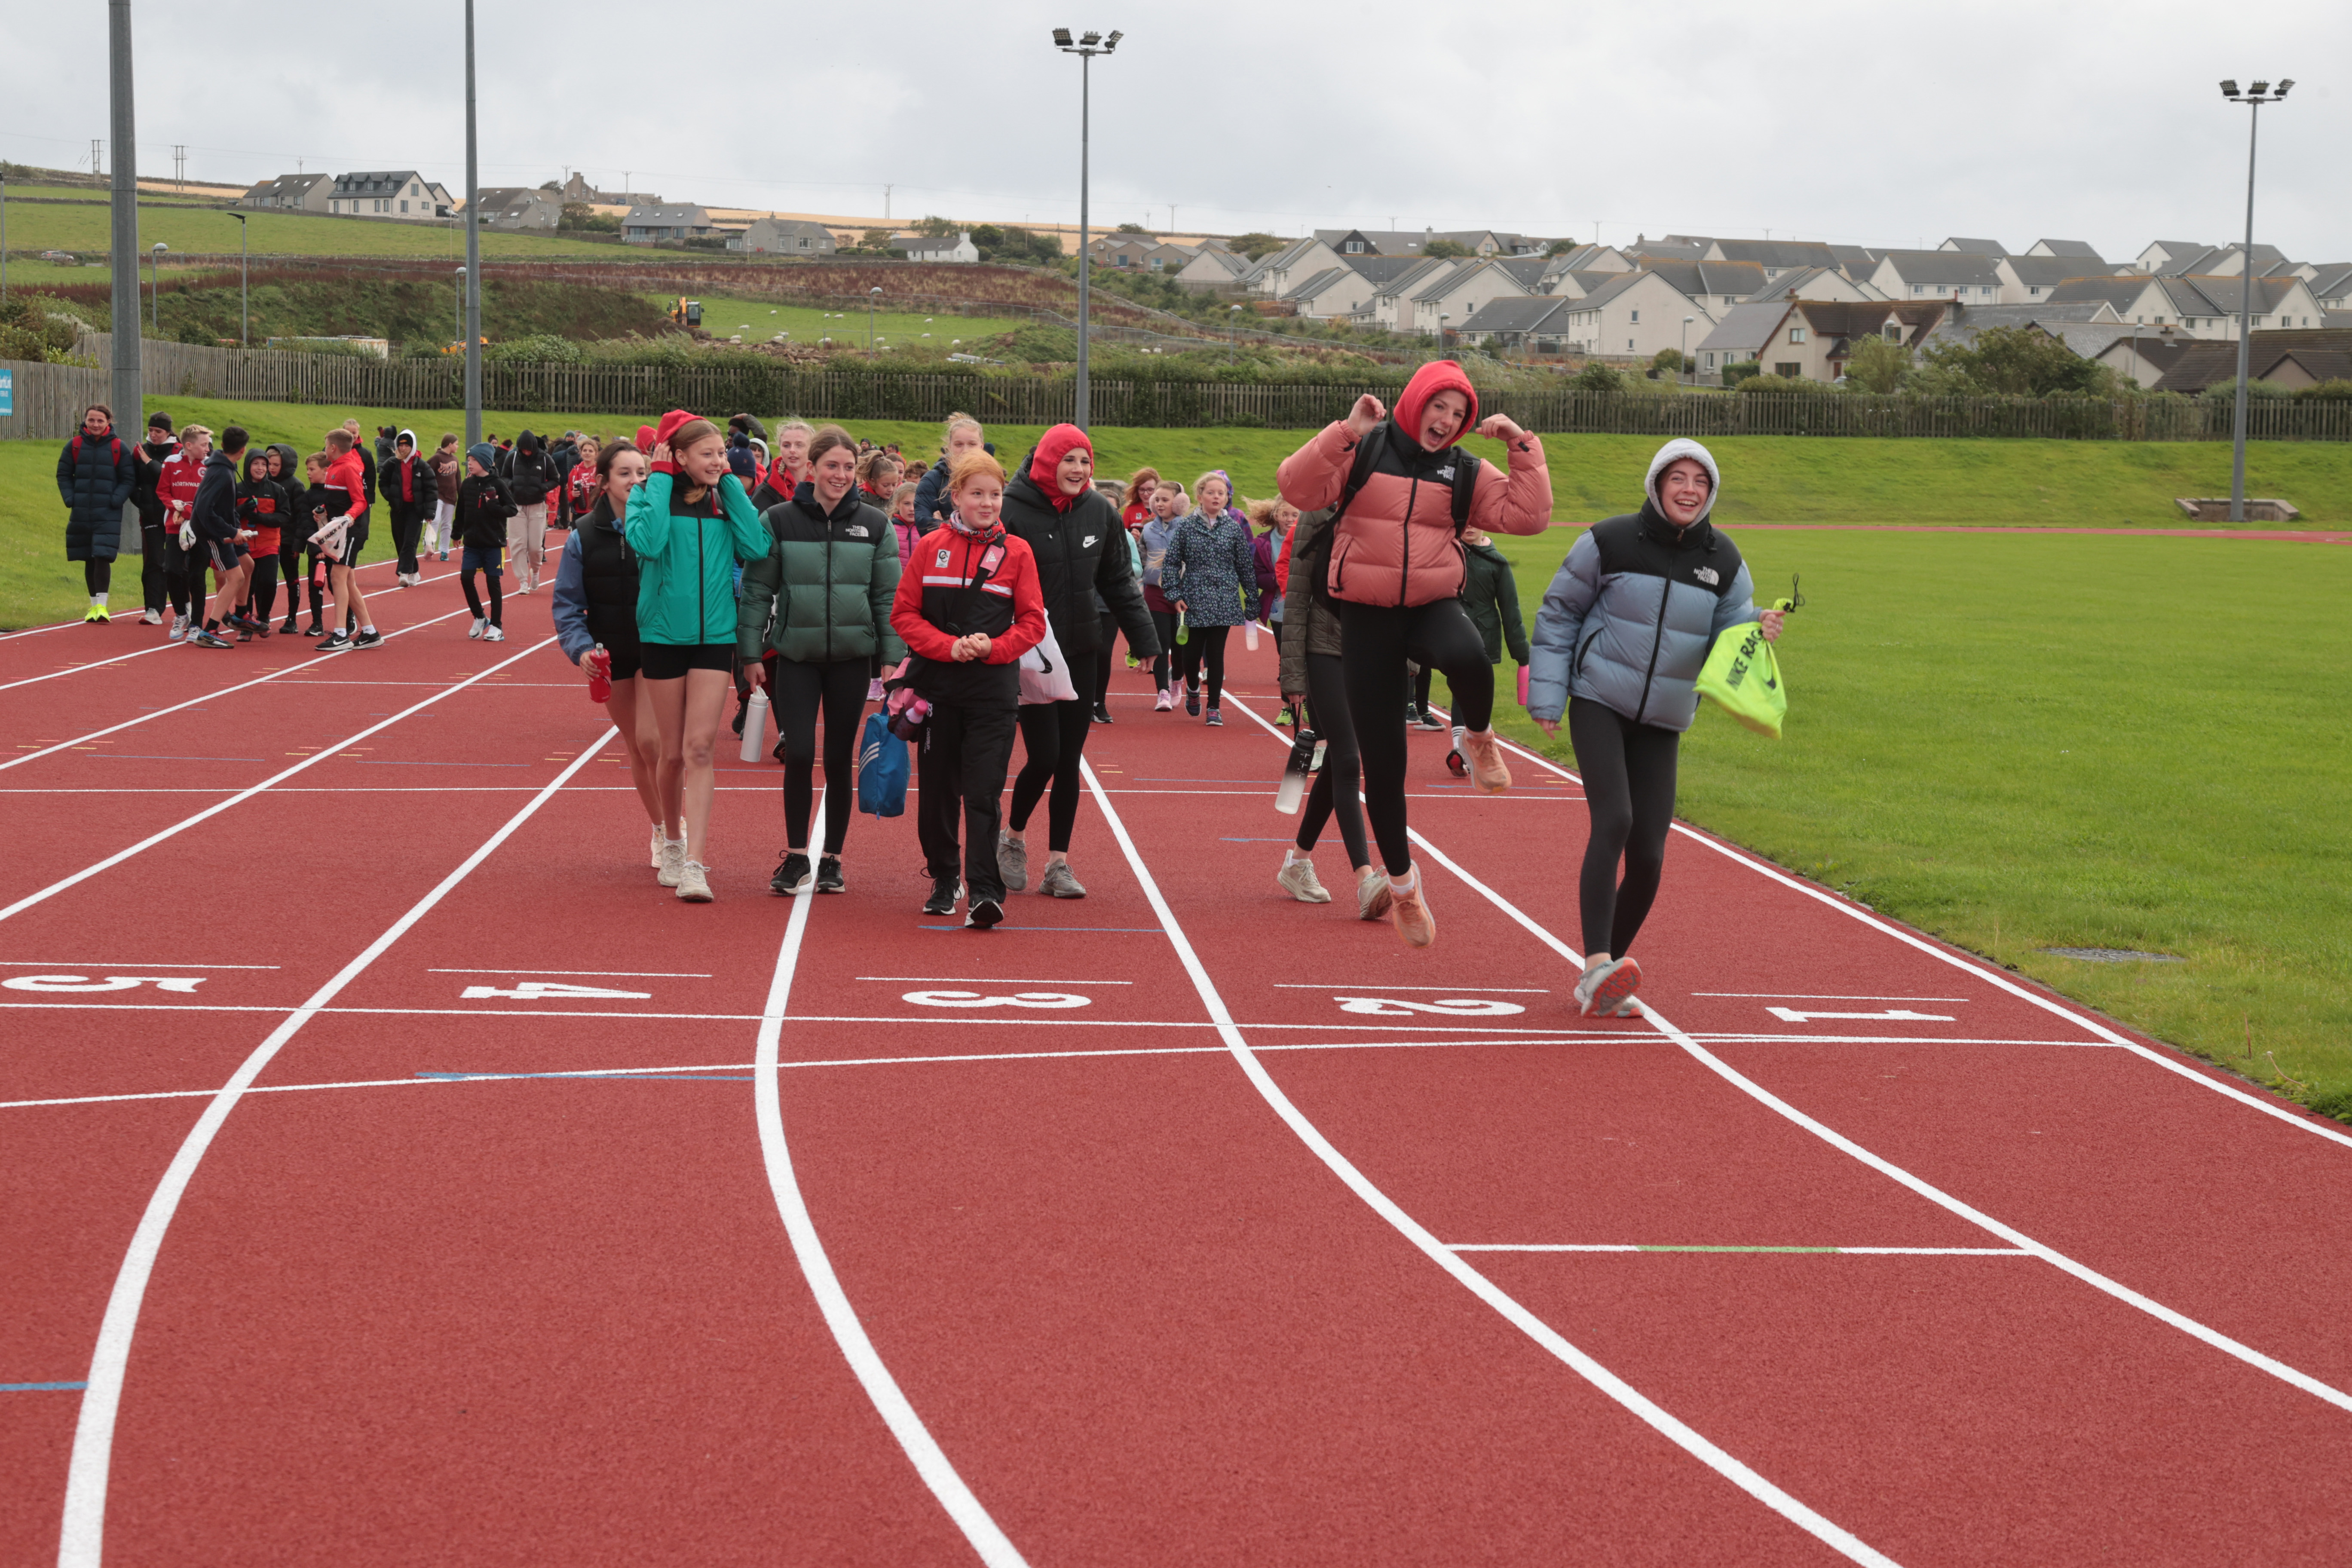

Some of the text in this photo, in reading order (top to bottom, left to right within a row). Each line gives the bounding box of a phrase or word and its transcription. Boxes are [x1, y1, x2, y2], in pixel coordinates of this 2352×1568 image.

[1694, 568, 1712, 579] NORTH
[1697, 574, 1711, 583] FACE
[1, 975, 207, 992] 5
[460, 982, 652, 999] 4
[902, 991, 1091, 1008] 3
[1334, 997, 1525, 1015] 2
[1765, 1007, 1957, 1022] 1
